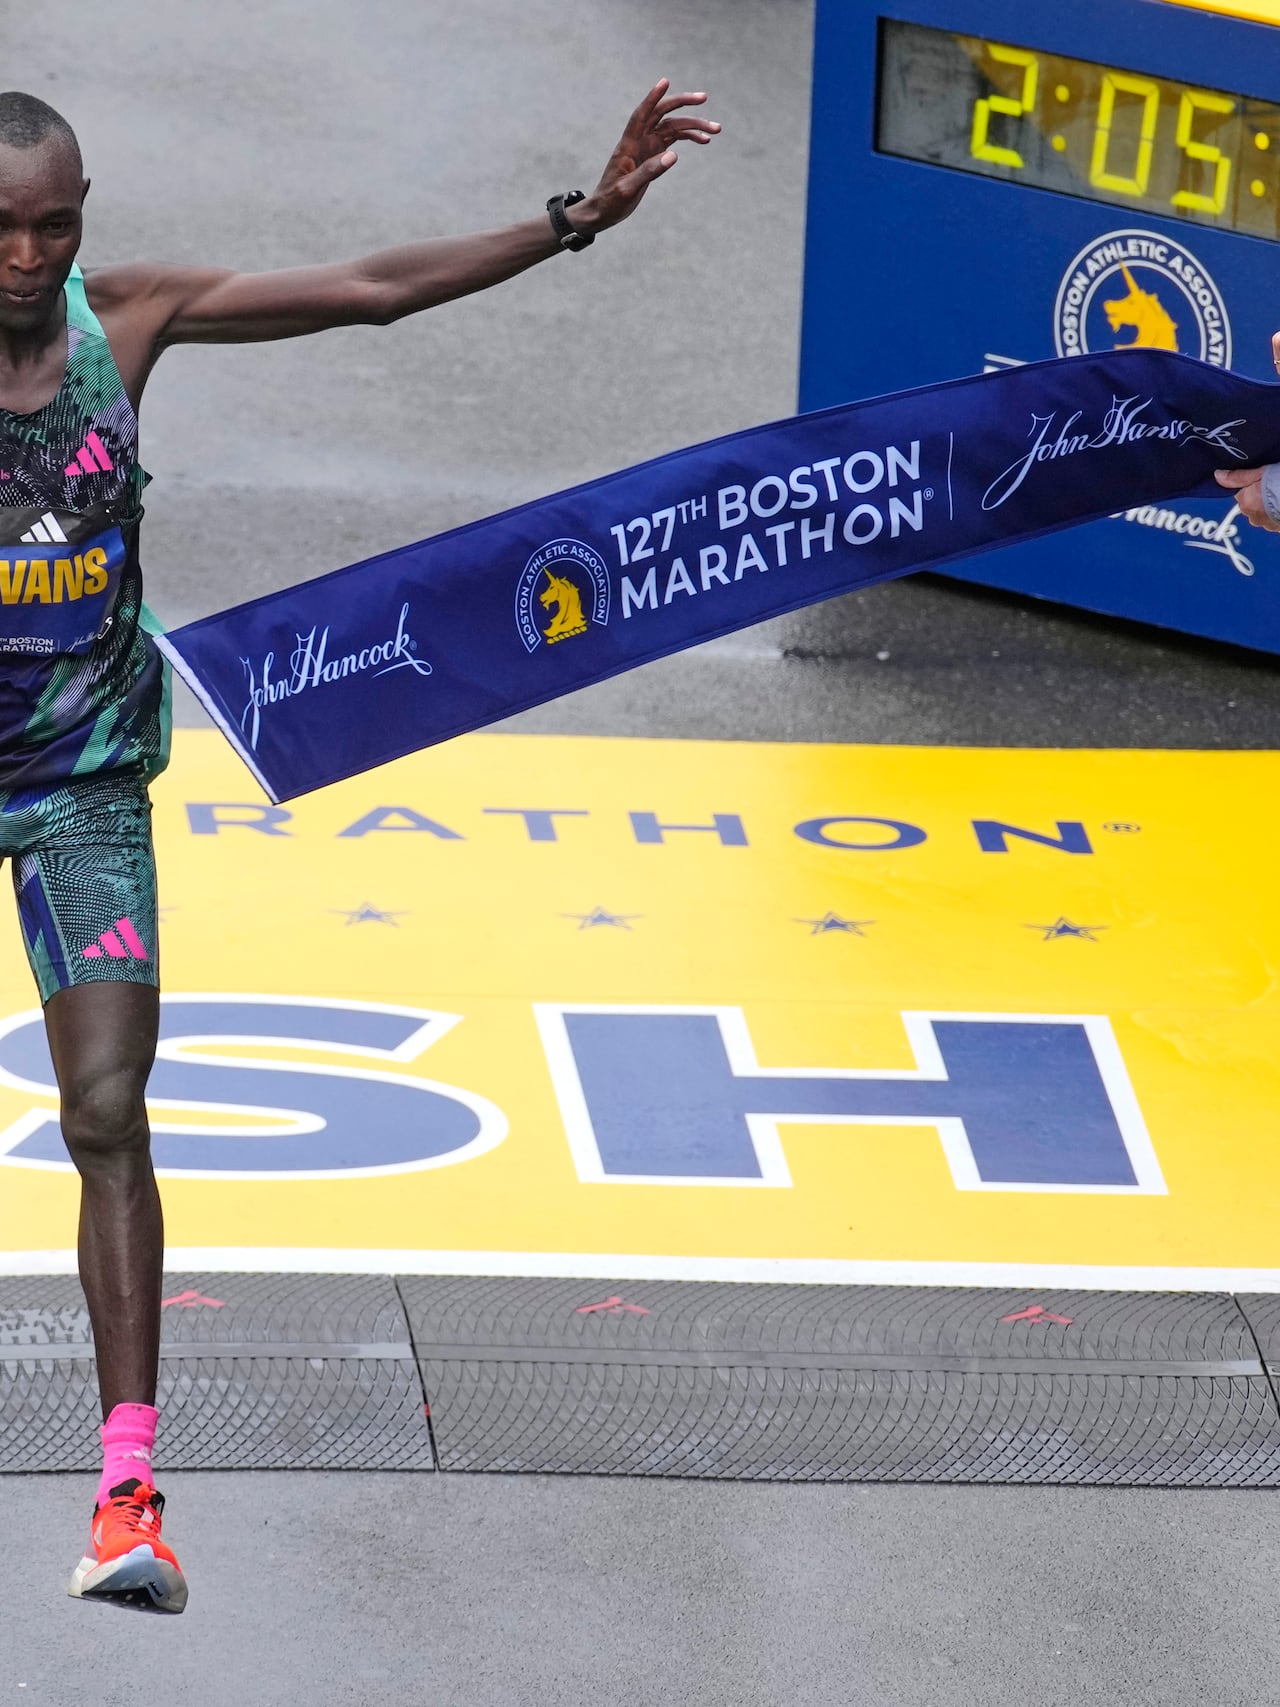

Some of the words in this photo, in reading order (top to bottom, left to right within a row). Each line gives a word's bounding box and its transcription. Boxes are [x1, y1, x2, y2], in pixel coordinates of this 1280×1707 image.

[1063, 272, 1089, 357] BOSTON
[1085, 239, 1169, 277] ATHLETIC
[1170, 255, 1224, 367] ASSOCIATI
[610, 495, 707, 566] 127TH
[717, 440, 920, 530] BOSTON
[982, 410, 1090, 510] John
[526, 544, 568, 584] ATHLETIC
[570, 546, 607, 618] ASSOCIATION
[9, 637, 54, 646] BOSTON
[520, 587, 537, 644] BOSTON
[239, 651, 293, 751] John
[289, 602, 433, 676] Hancock
